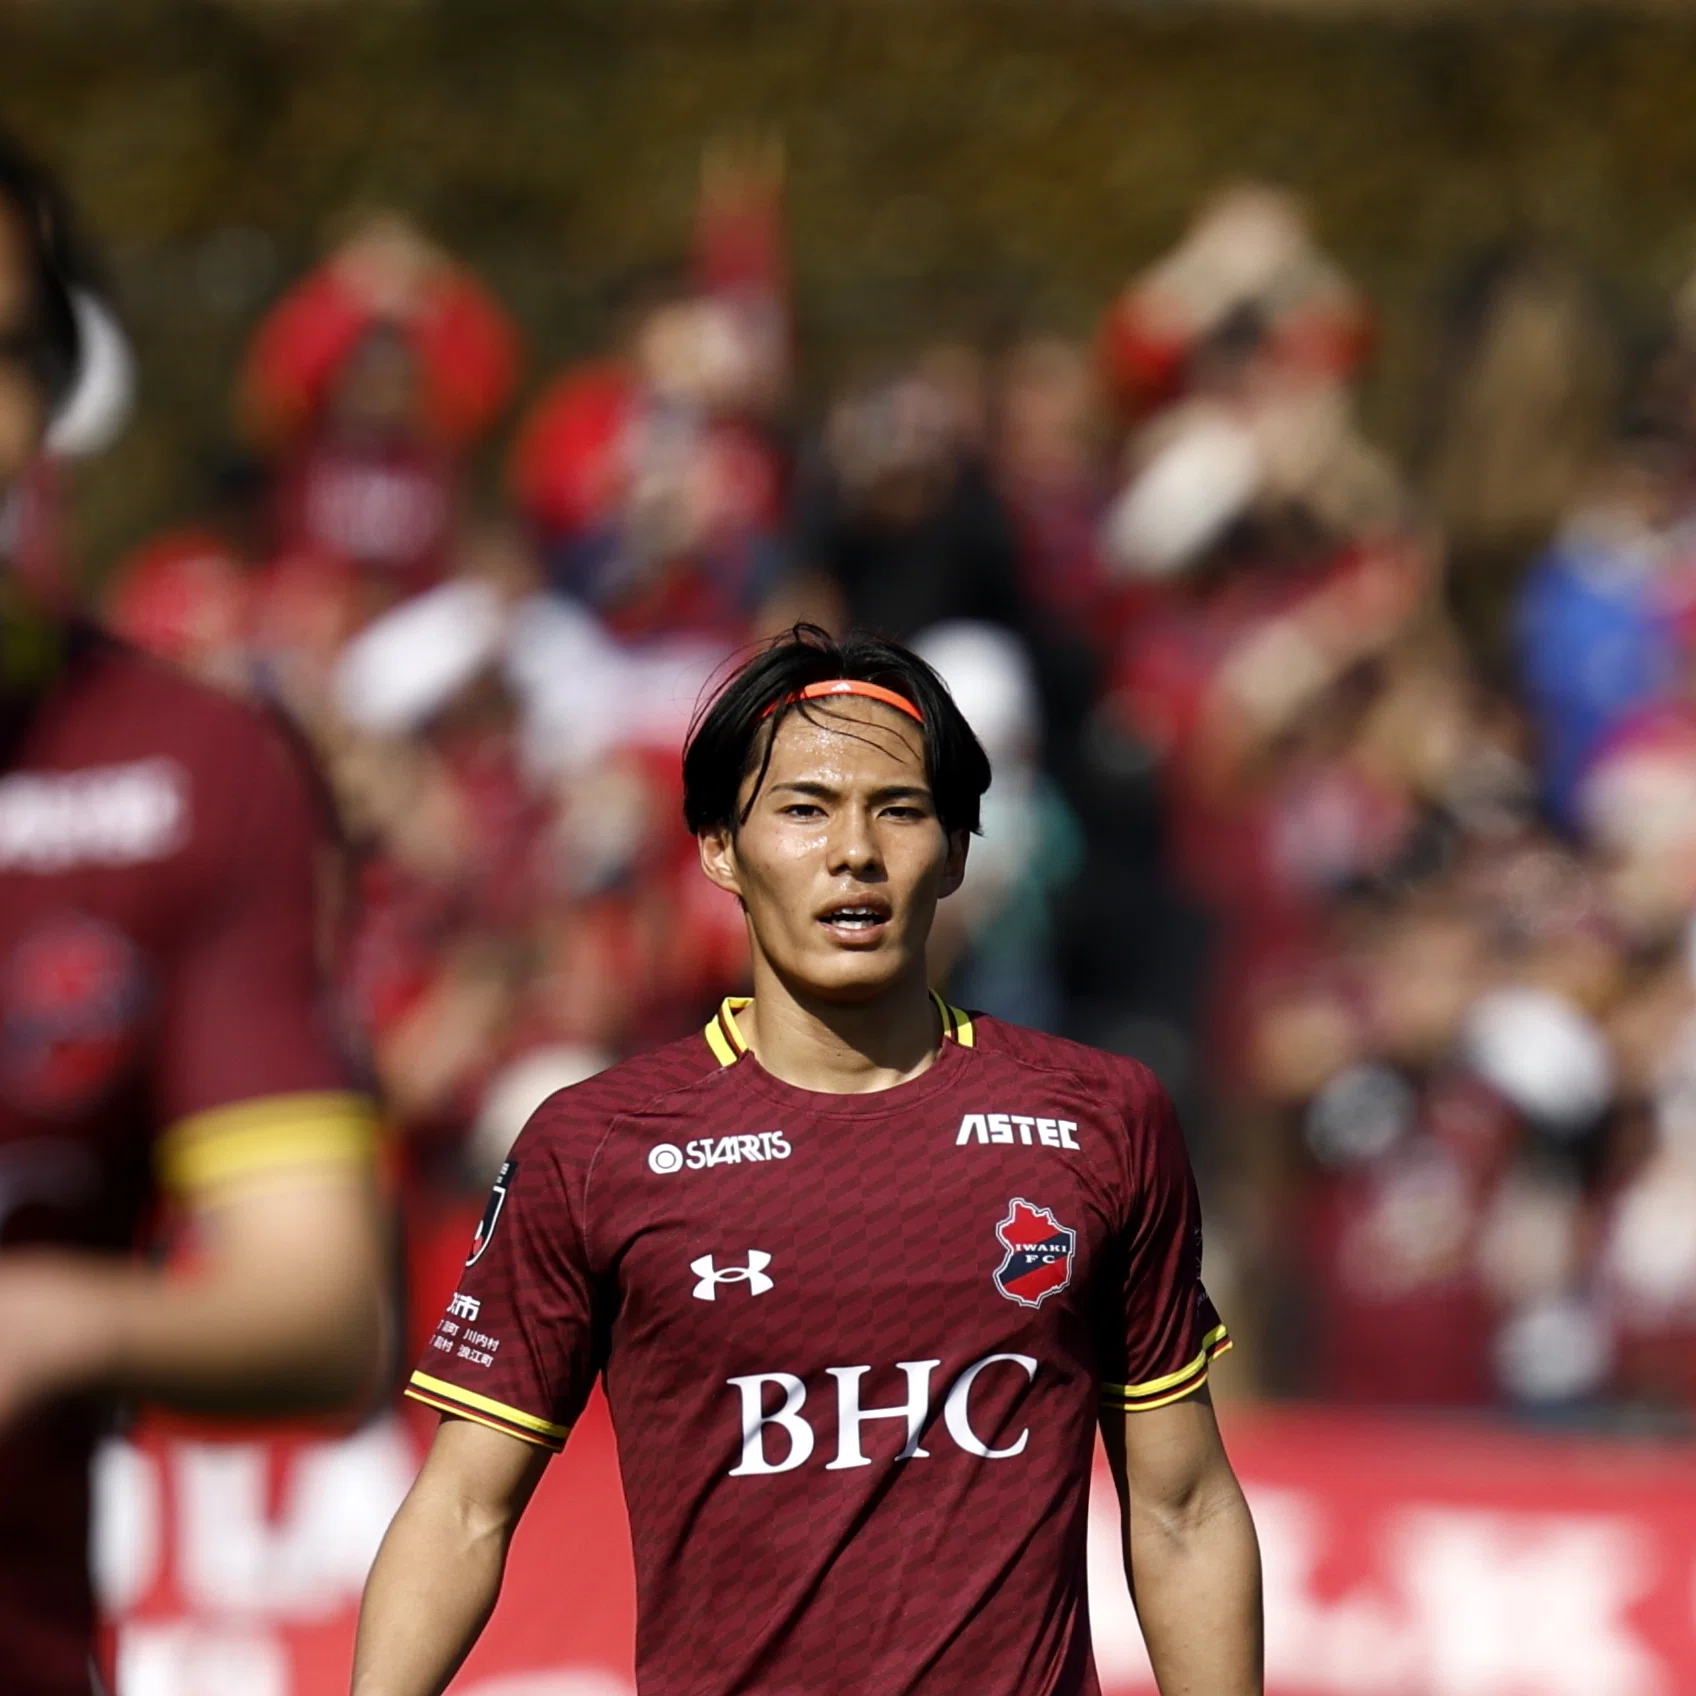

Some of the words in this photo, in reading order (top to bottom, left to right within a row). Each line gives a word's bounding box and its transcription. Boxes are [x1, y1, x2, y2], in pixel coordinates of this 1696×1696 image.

[955, 1112, 1081, 1151] ASTEC
[1015, 1243, 1067, 1253] IWAKI
[726, 1353, 1038, 1477] BHC
